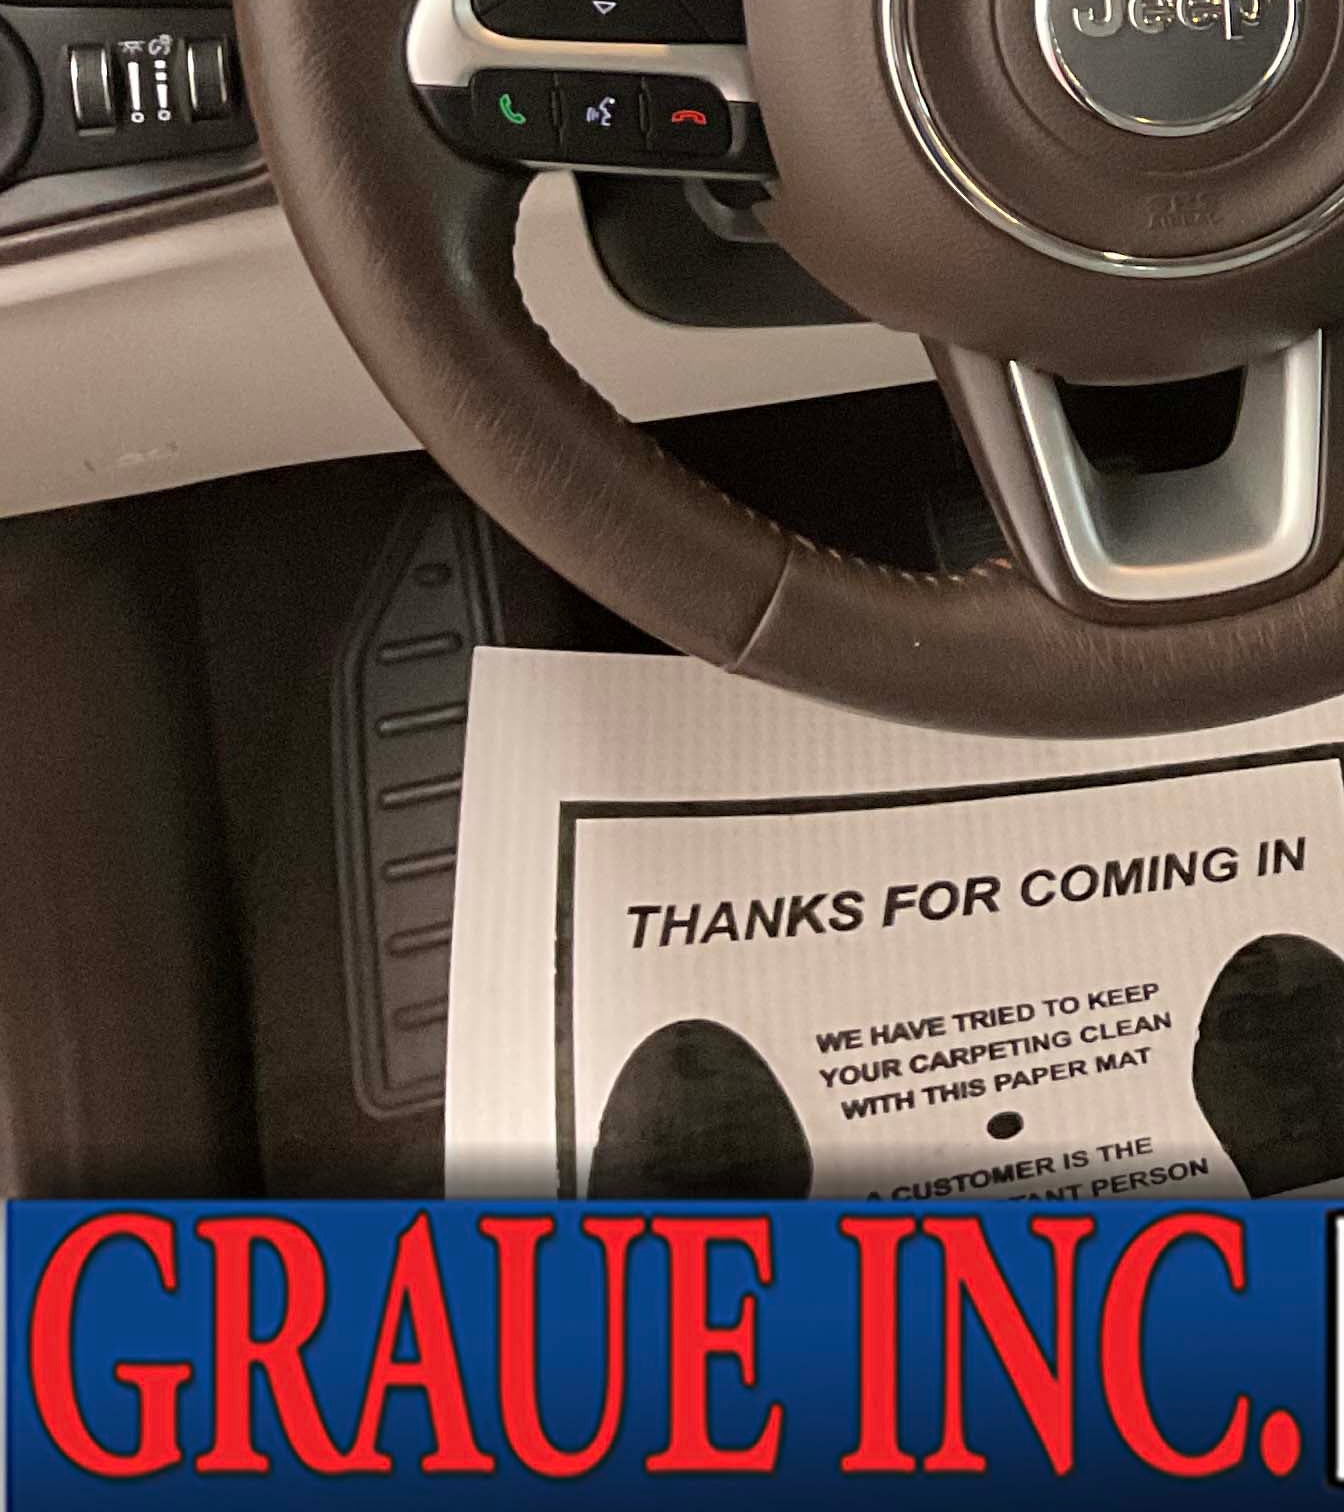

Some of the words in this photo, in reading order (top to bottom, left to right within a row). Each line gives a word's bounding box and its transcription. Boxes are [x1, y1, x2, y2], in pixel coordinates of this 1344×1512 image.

[627, 889, 865, 949] THANKS
[882, 875, 1001, 928] FOR
[1020, 846, 1239, 907] COMING
[1257, 836, 1306, 876] IN
[816, 1028, 863, 1054] WE
[869, 1015, 947, 1047] HAVE
[952, 1003, 1036, 1033] TRIED
[1042, 996, 1080, 1018] TO
[1087, 982, 1160, 1010] KEEP
[818, 1056, 904, 1088] YOUR
[909, 1029, 1074, 1075] CARPETING
[1080, 1011, 1173, 1044] CLEAN
[840, 1089, 916, 1121] WITH
[921, 1077, 987, 1105] THIS
[993, 1059, 1088, 1093] PAPER
[1095, 1046, 1153, 1073] MAT
[890, 1157, 1056, 1201] CUSTOMER
[1063, 1149, 1090, 1170] IS
[1096, 1136, 1154, 1163] THE
[1091, 1157, 1210, 1199] PERSON
